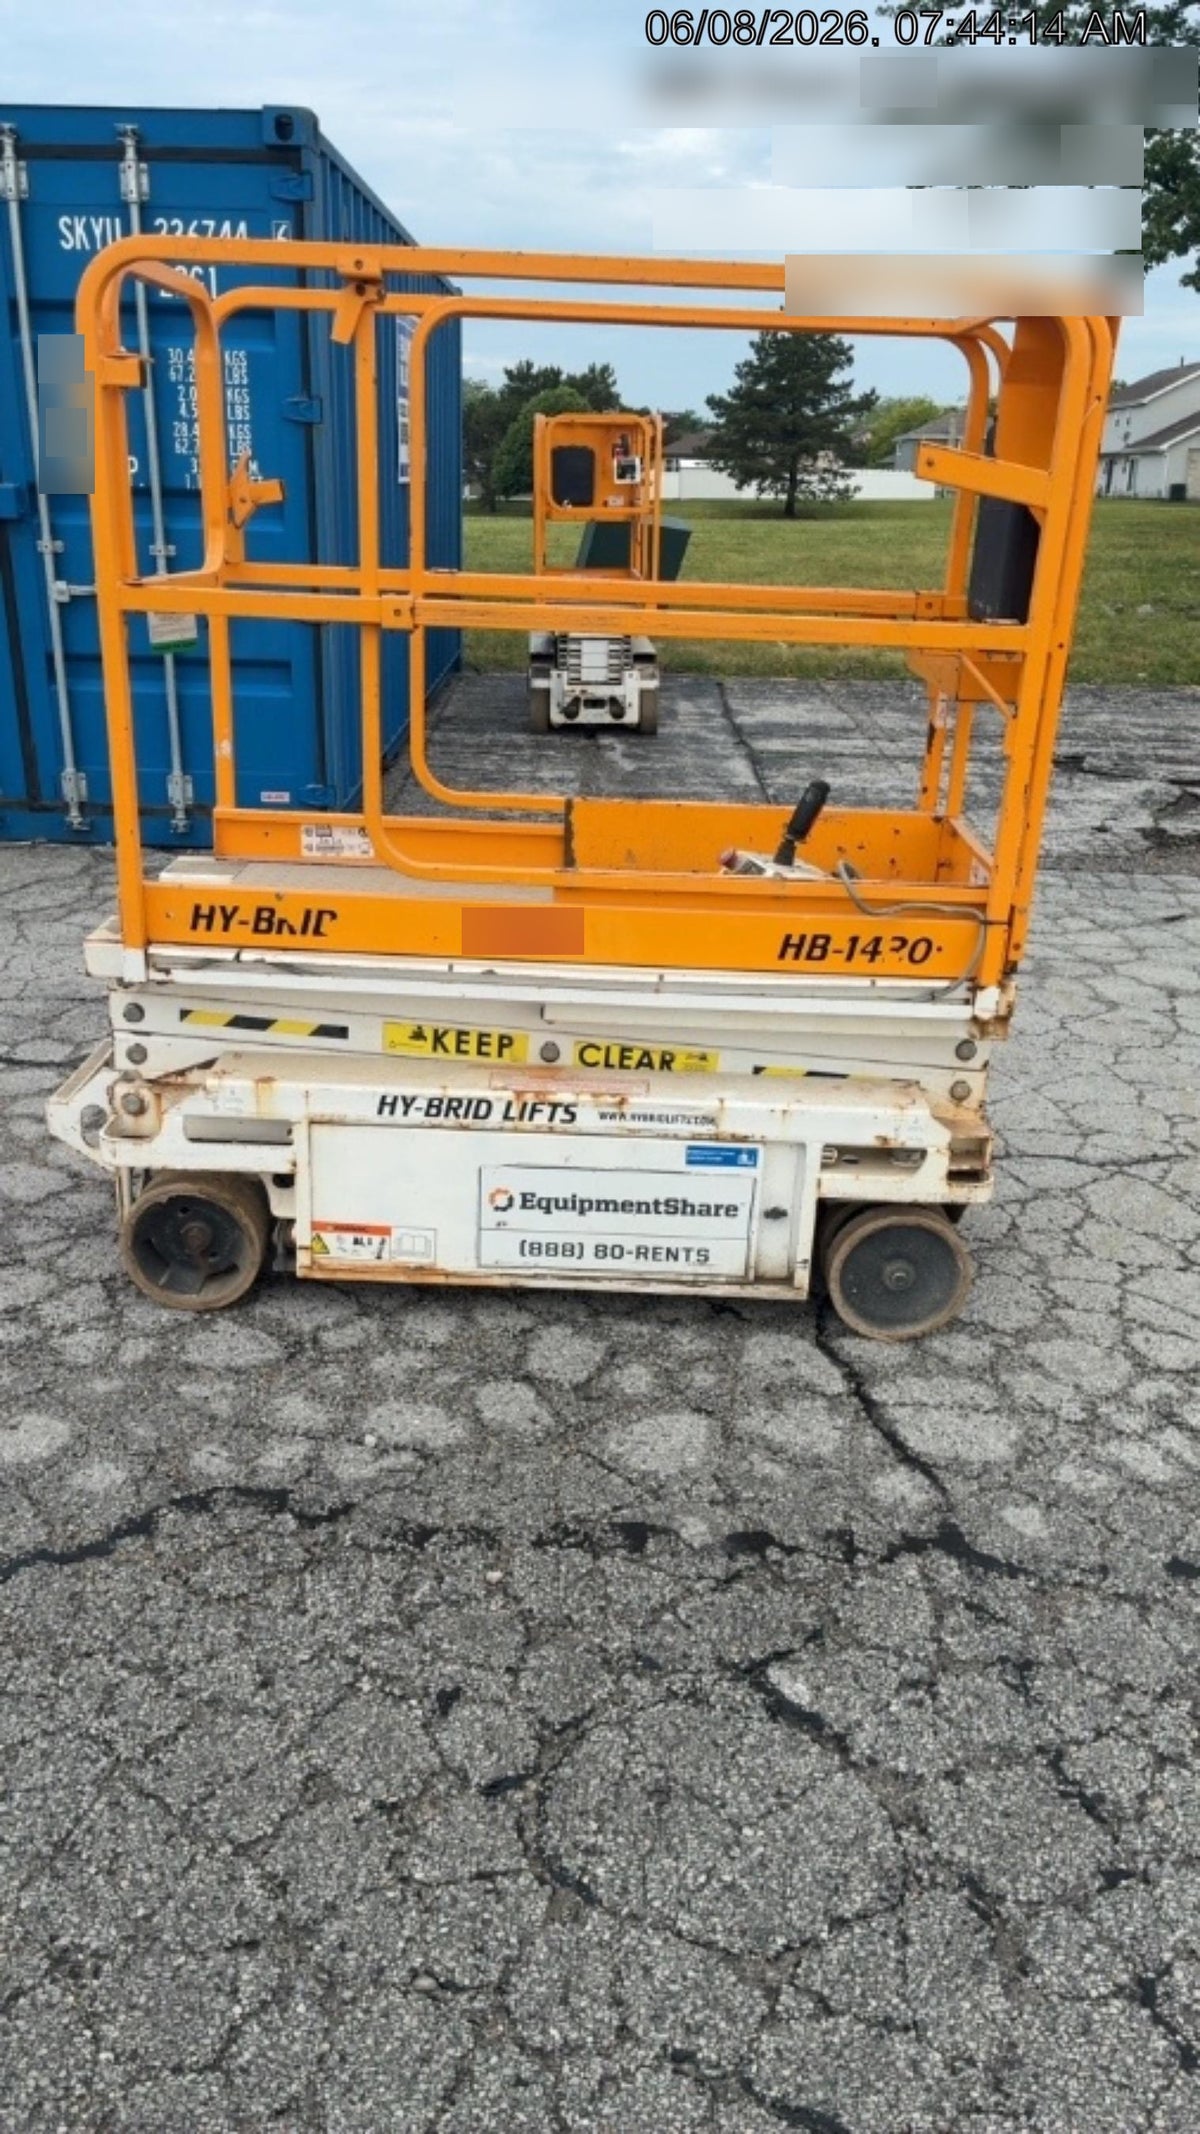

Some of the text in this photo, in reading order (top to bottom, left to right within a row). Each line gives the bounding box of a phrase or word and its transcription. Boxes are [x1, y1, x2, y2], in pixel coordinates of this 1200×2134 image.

[58, 215, 122, 250] SKYU
[224, 350, 248, 366] KGS
[225, 366, 249, 385] LBS
[226, 388, 250, 404] KGS
[227, 404, 251, 420] LBS
[229, 423, 252, 439] KGS
[431, 1028, 514, 1058] KEEP
[577, 1042, 676, 1071] CLEAR
[376, 1095, 578, 1124] HY-BRID LIFTS
[519, 1191, 739, 1218] EquipmentShare
[518, 1239, 711, 1264] (888) 80-RENTS
